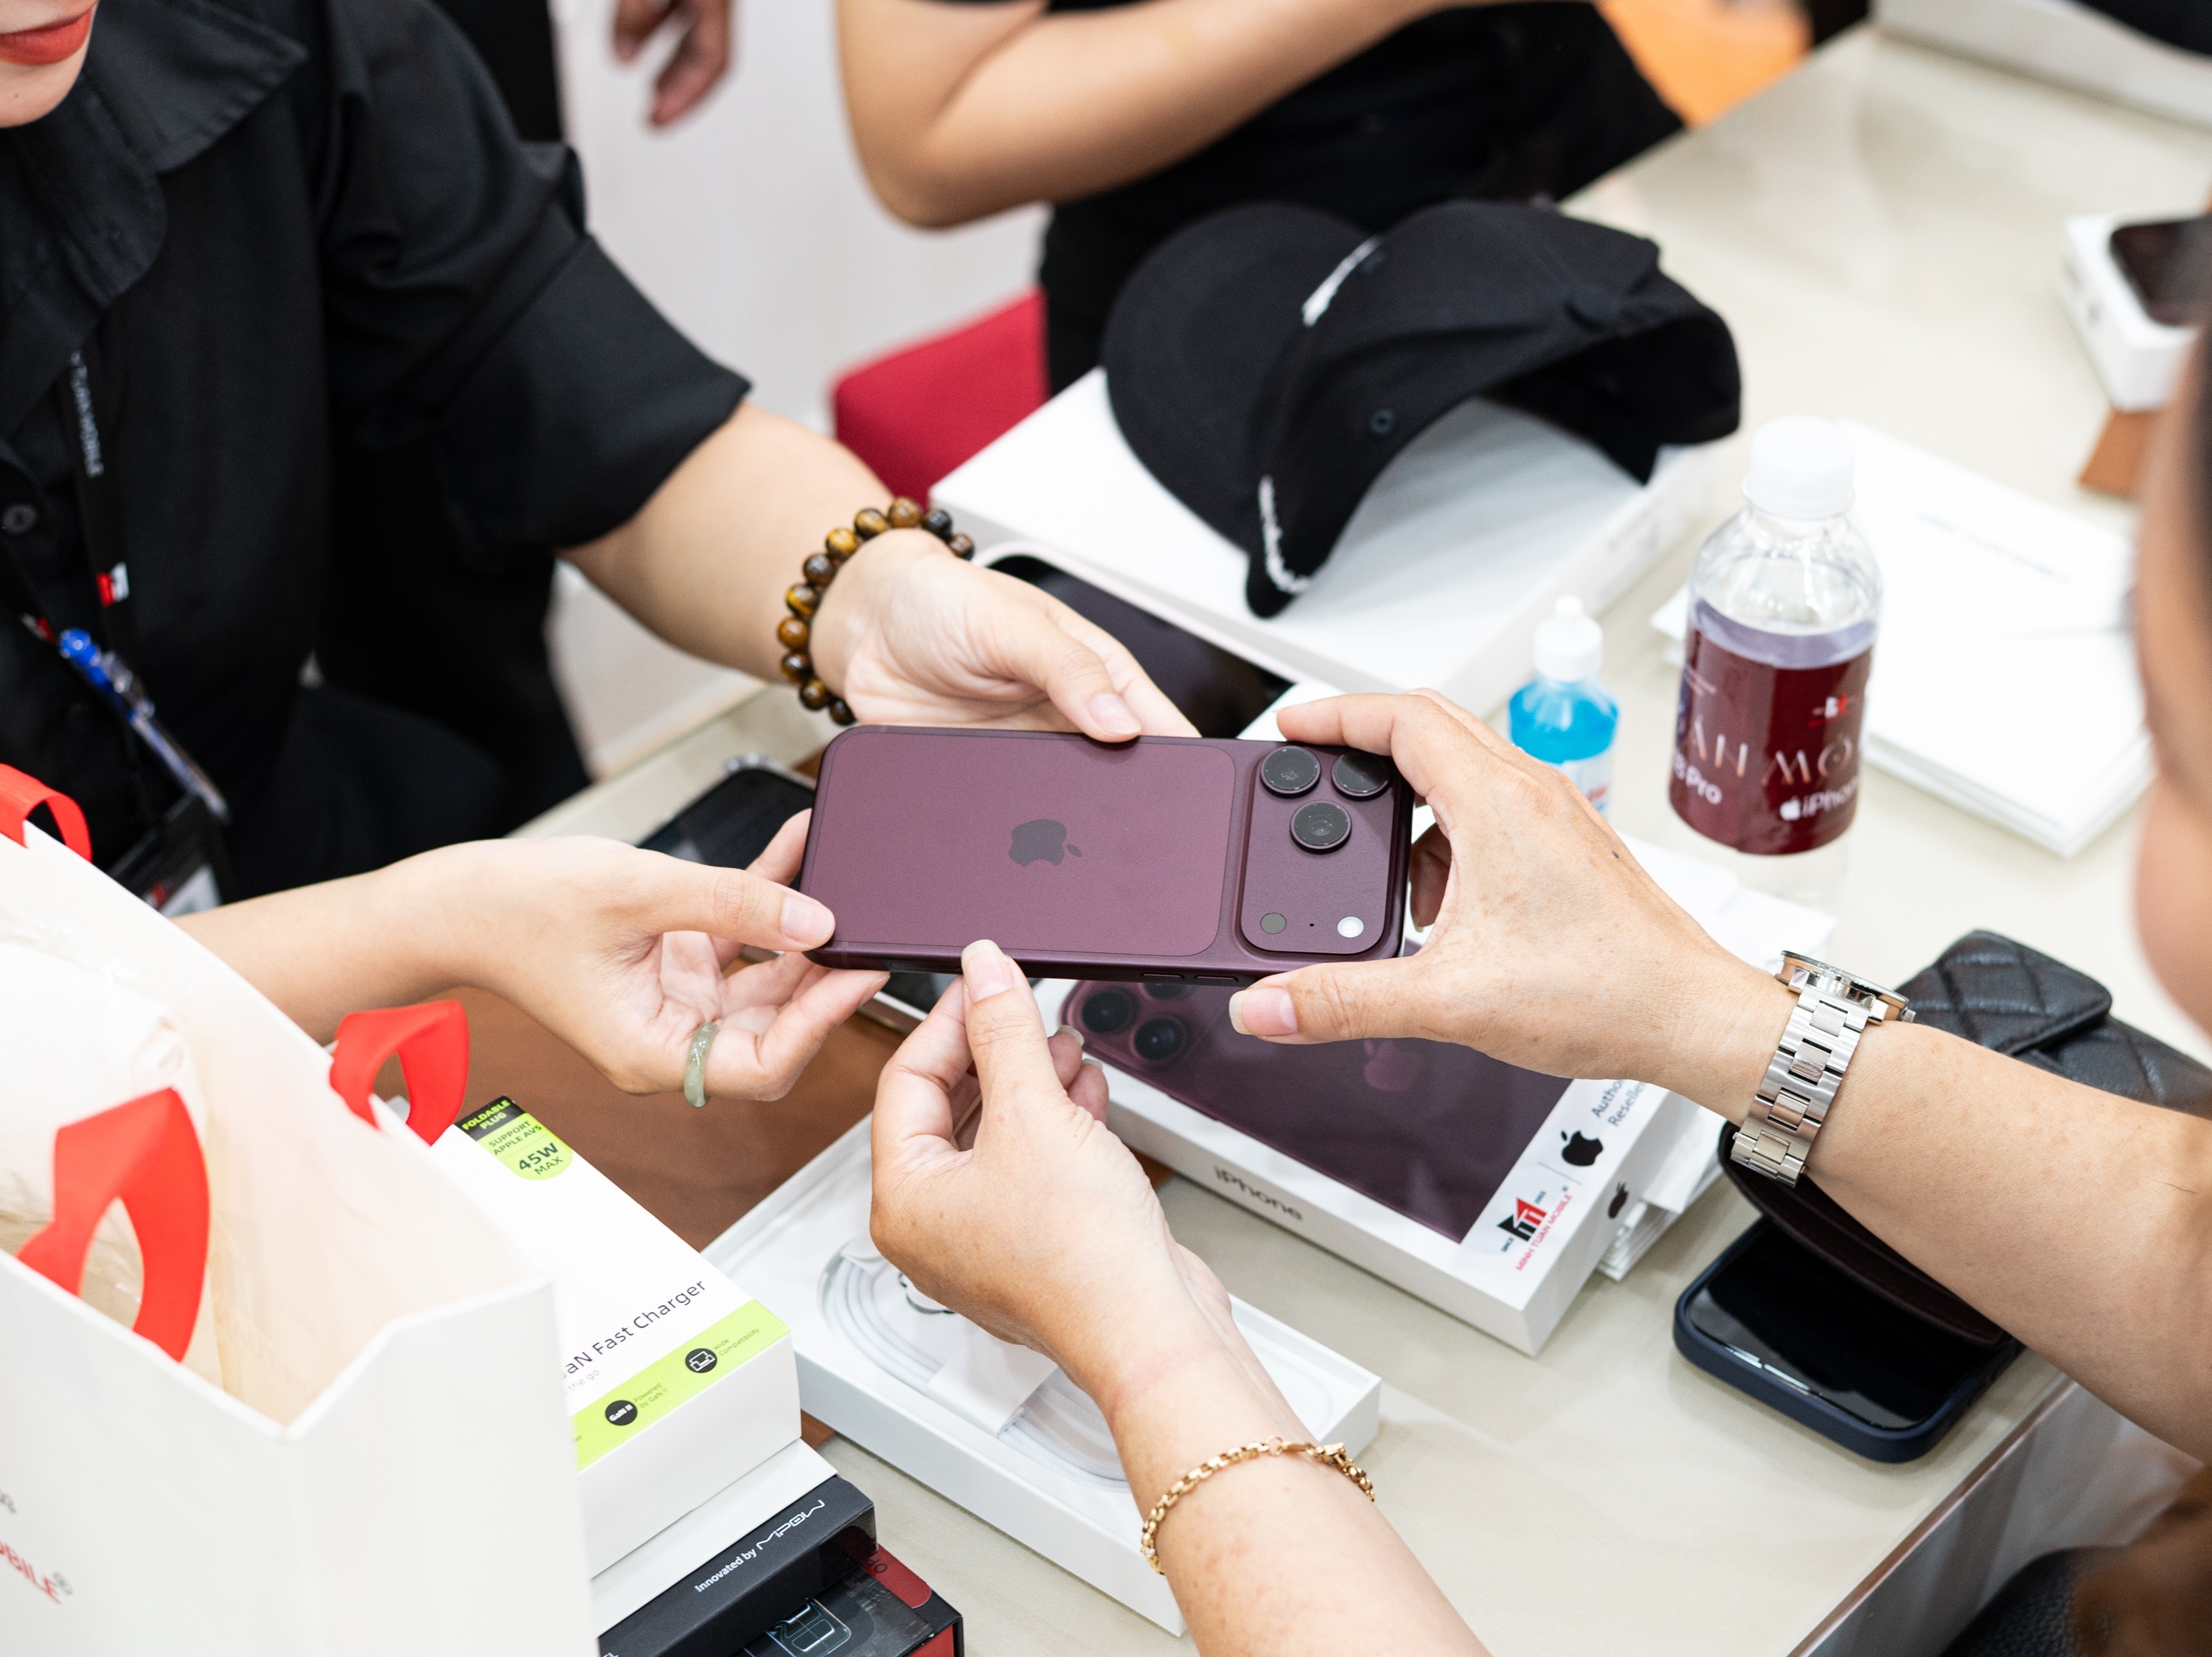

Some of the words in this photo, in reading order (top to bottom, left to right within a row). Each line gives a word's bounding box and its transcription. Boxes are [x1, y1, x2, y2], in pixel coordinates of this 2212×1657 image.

[462, 1100, 511, 1130] FOLDABLE
[479, 1111, 507, 1130] PLUG
[489, 1120, 532, 1147] SUPPORT
[493, 1136, 523, 1156] APPLE
[518, 1142, 559, 1171] 45W
[534, 1156, 563, 1175] MAX
[1214, 1164, 1303, 1220] iPhone
[1548, 1192, 1572, 1225] MOBILE
[561, 1352, 593, 1380] aN
[592, 1327, 634, 1355] Fast
[633, 1280, 706, 1329] Charger
[718, 1327, 761, 1357] Compatibility
[712, 1337, 730, 1351] Wide
[568, 1379, 585, 1392] the
[586, 1369, 600, 1381] go
[633, 1383, 662, 1403] Powered
[639, 1399, 650, 1409] by
[648, 1392, 664, 1403] GaN
[694, 1557, 745, 1593] Innovated
[740, 1549, 757, 1560] by
